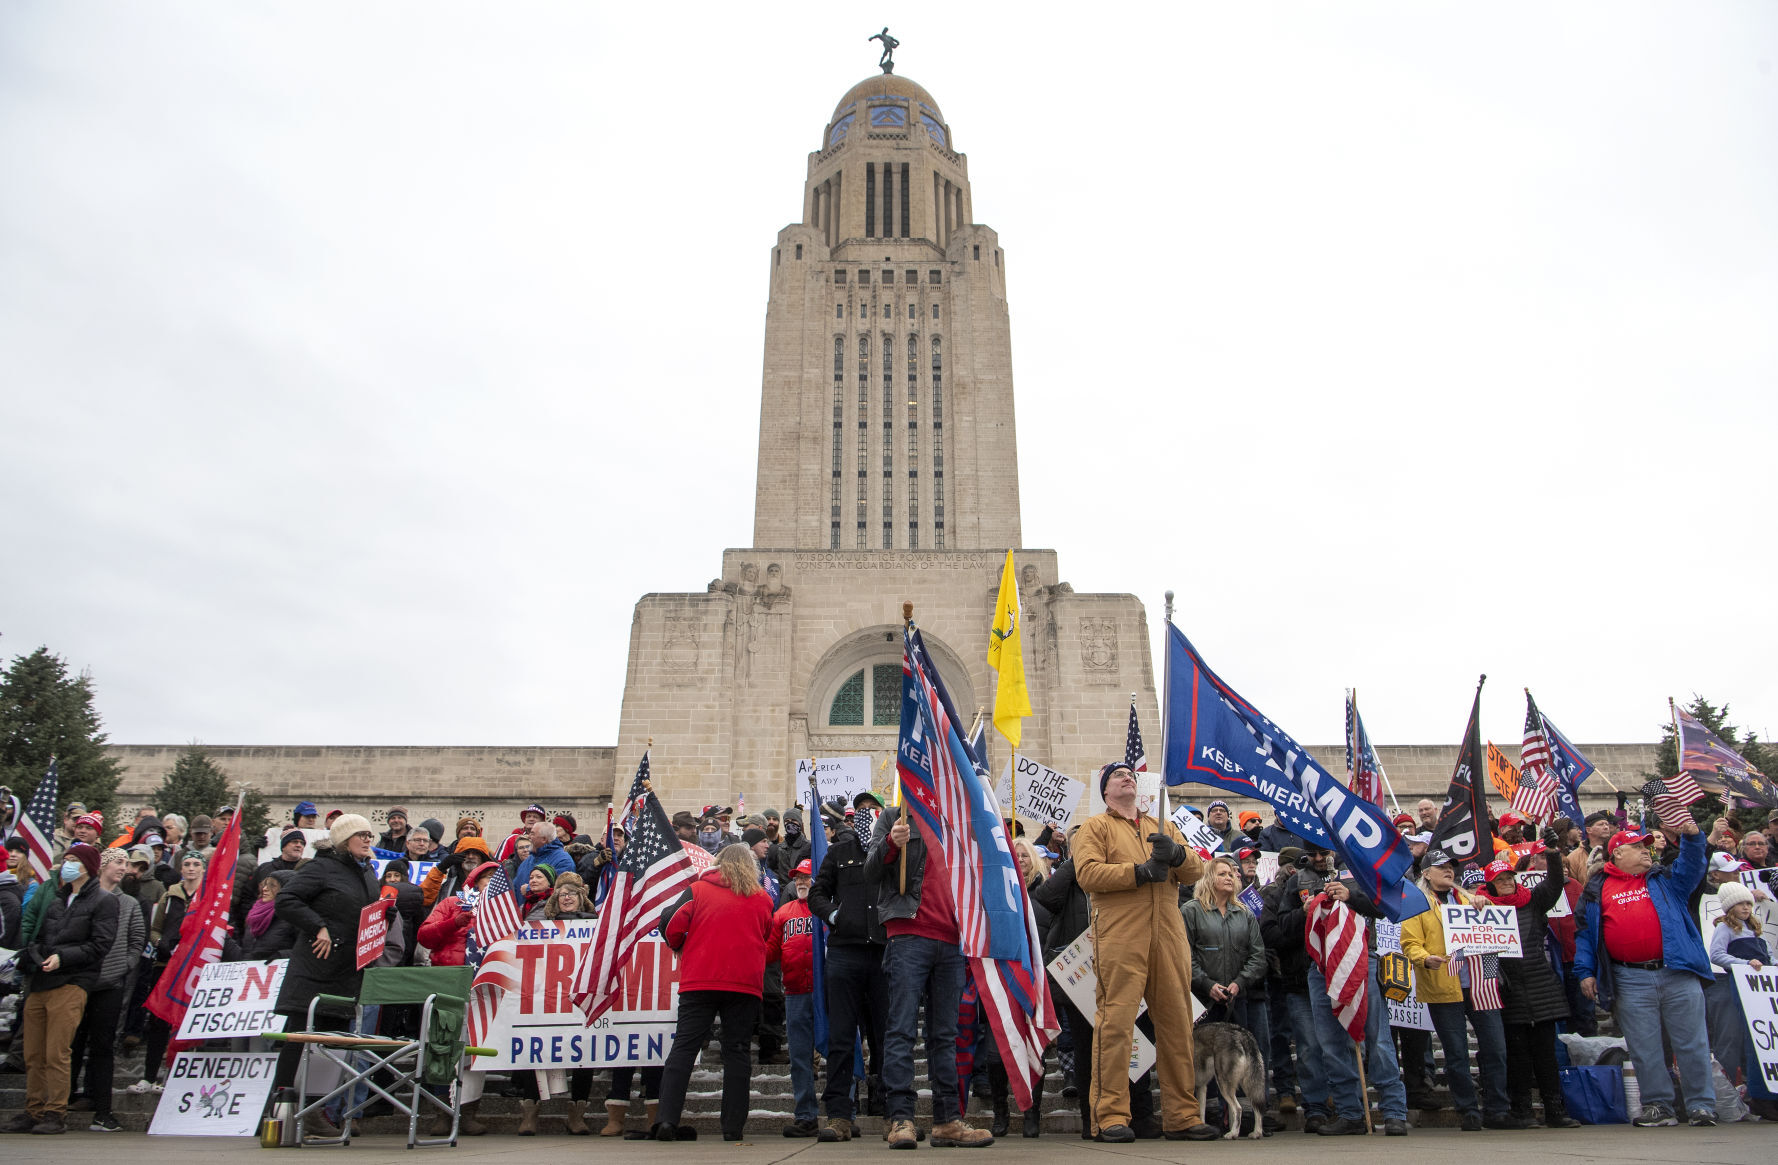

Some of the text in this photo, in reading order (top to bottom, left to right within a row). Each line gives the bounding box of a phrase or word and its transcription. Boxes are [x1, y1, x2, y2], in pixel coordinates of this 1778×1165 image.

[795, 554, 986, 562] WISDOM JUSTICE POWER MERCY
[901, 737, 930, 772] KEE
[1488, 743, 1522, 786] STOP TH
[1017, 758, 1069, 792] DO THE
[1028, 780, 1067, 805] RIGHT
[1249, 775, 1321, 818] AMERIC
[407, 810, 452, 819] INCOLN
[1028, 795, 1071, 825] THING!
[368, 910, 382, 923] MAKE
[1447, 908, 1512, 925] PRAY
[359, 920, 386, 943] AMERICA
[517, 928, 560, 940] KEEP
[784, 917, 813, 943] HUSK
[1451, 933, 1518, 945] AMERICA
[1472, 925, 1493, 933] FOR
[358, 936, 385, 957] GREAT AGAIN
[1055, 943, 1081, 972] DEEP
[516, 942, 681, 1015] TRMP
[191, 987, 234, 1009] DEB
[187, 1009, 277, 1034] FISCHER
[593, 1018, 609, 1029] OR
[1388, 1008, 1422, 1027] SASSE!
[173, 1057, 277, 1079] BENEDICT
[178, 1091, 246, 1115] S E
